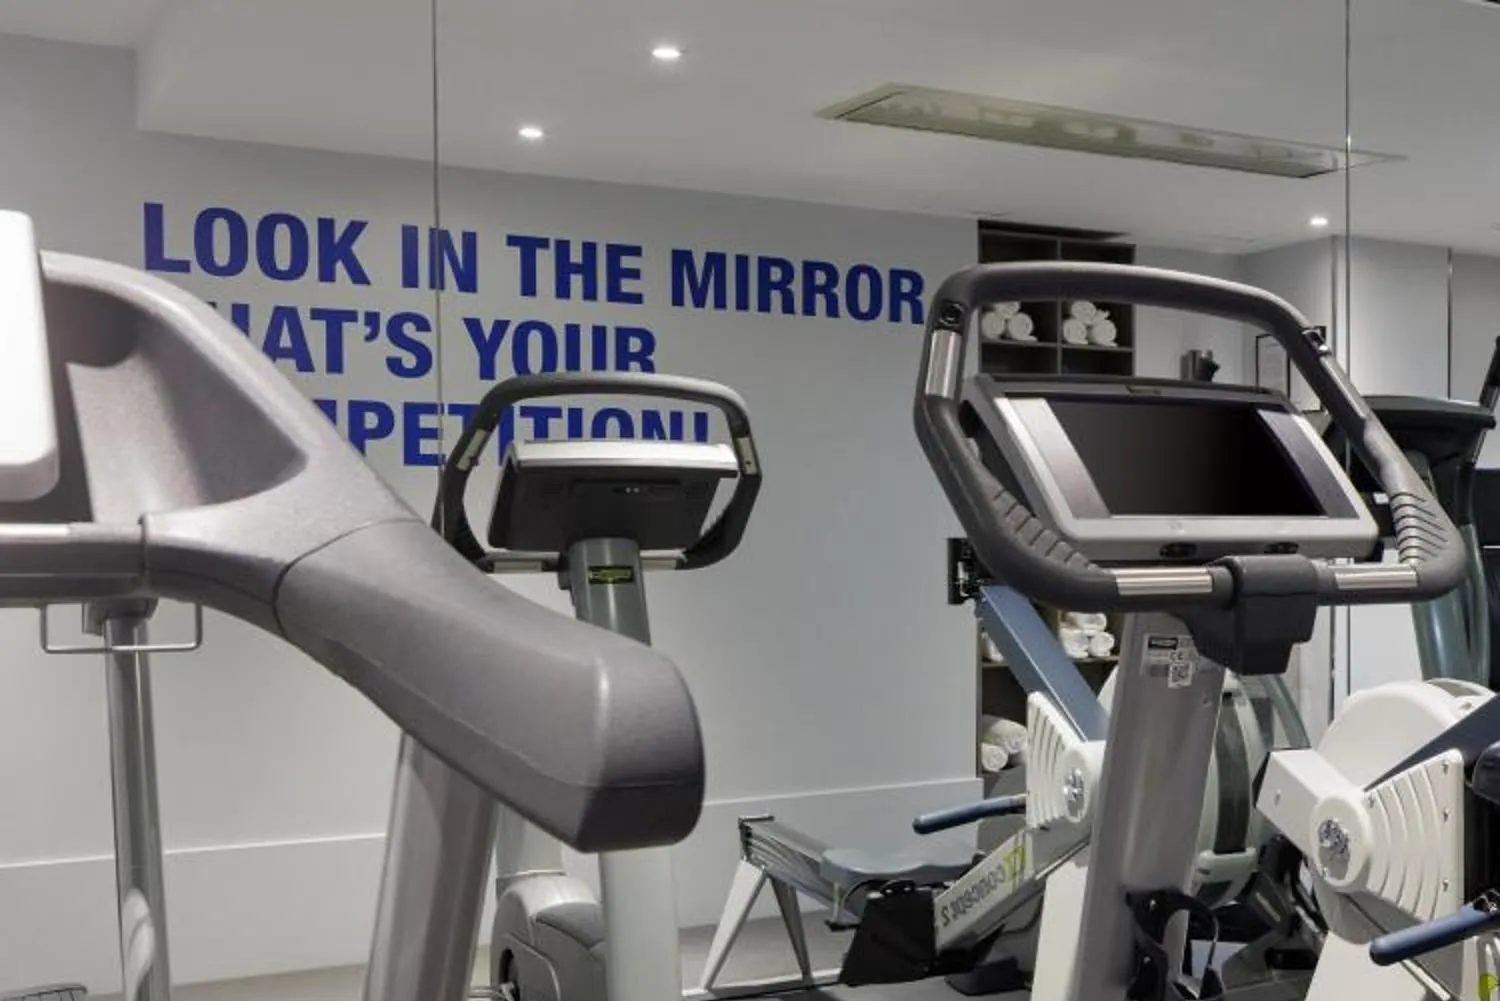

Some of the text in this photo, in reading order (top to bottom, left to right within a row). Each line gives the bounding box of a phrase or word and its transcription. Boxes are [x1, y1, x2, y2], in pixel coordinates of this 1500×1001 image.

[143, 202, 925, 325] LOOK IN THE MIRROR
[208, 302, 656, 380] AT'S YOUR
